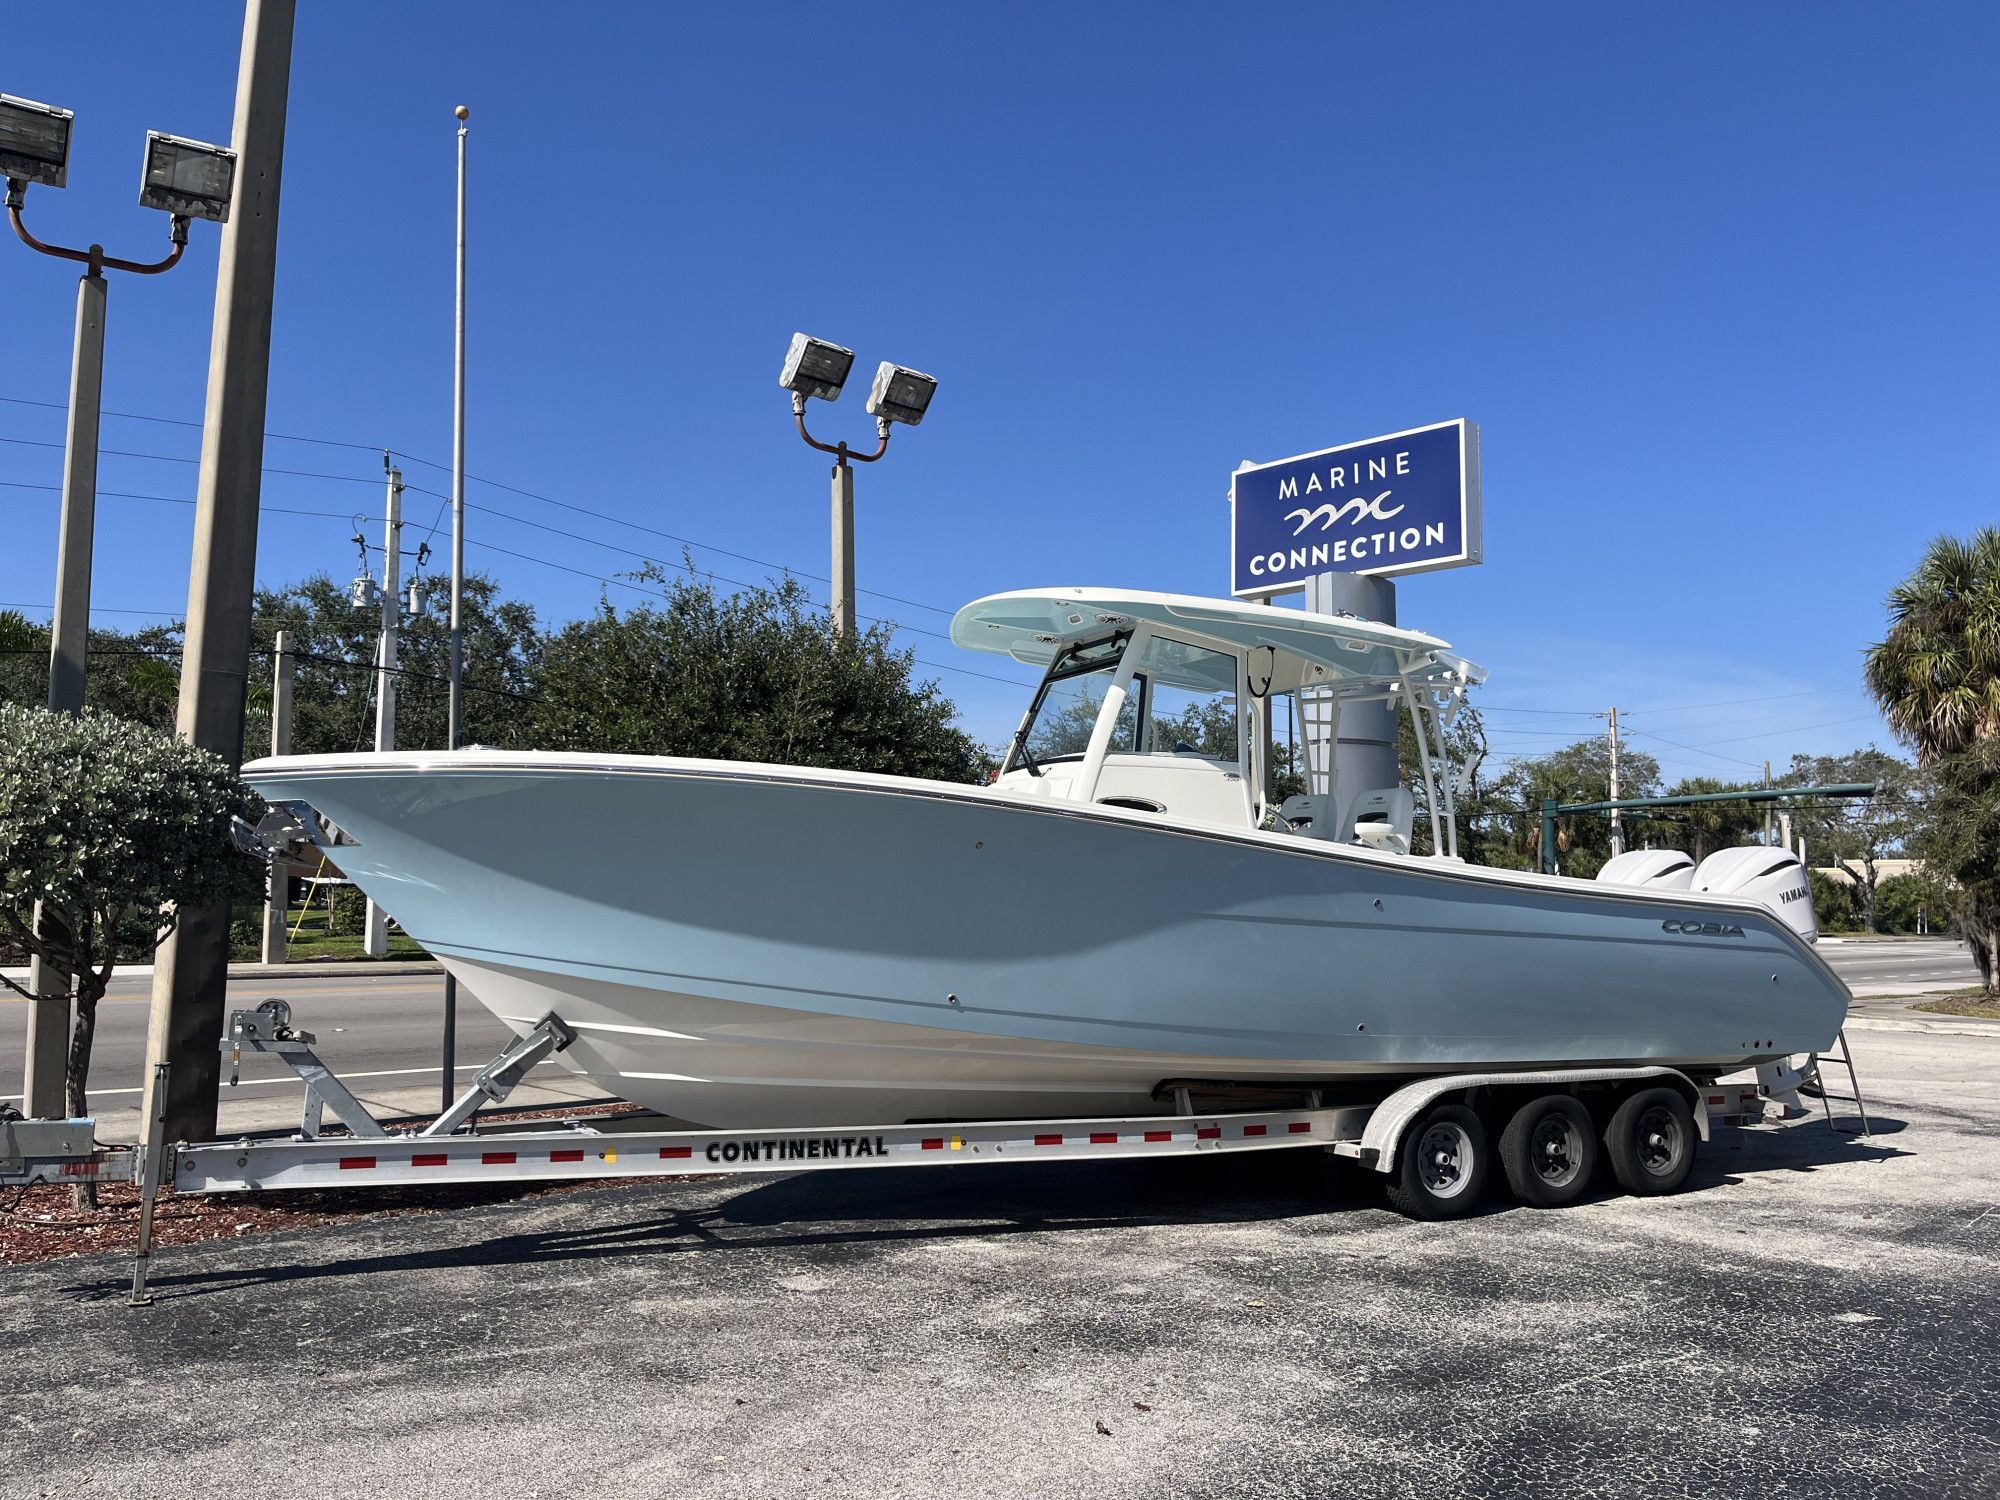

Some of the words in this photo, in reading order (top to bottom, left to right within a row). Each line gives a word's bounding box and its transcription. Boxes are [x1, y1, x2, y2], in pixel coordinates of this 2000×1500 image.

[1278, 452, 1410, 500] MARINE
[1249, 521, 1445, 576] CONNECTION
[1779, 885, 1808, 905] YAMAH
[1661, 919, 1747, 939] COBIA
[705, 1136, 889, 1163] CONTINENTAL
